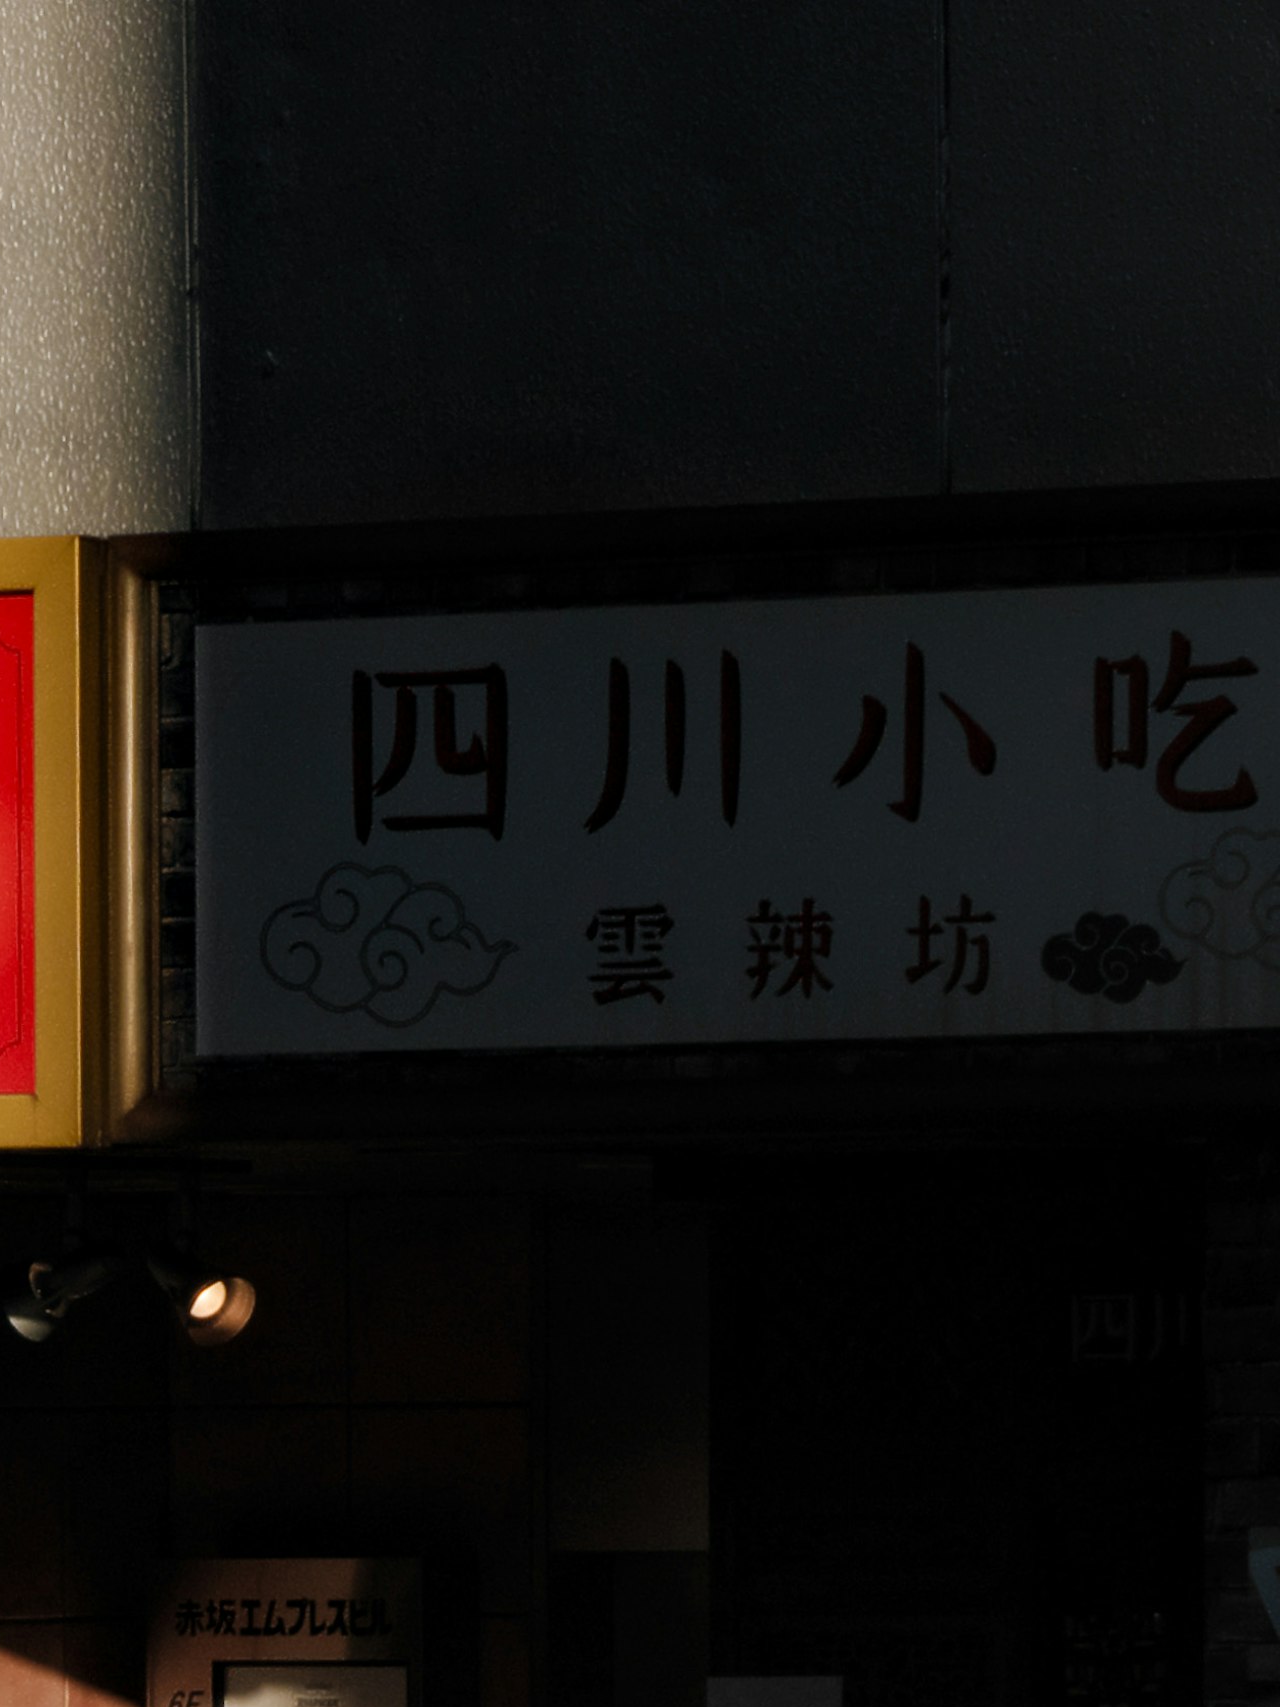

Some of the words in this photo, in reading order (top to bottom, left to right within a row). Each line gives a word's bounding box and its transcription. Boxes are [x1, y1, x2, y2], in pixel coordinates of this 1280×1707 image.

[351, 630, 1259, 846] 四川小吃
[585, 893, 997, 1006] 雲辣坊
[175, 1598, 393, 1636] 赤坂エムプレスビル
